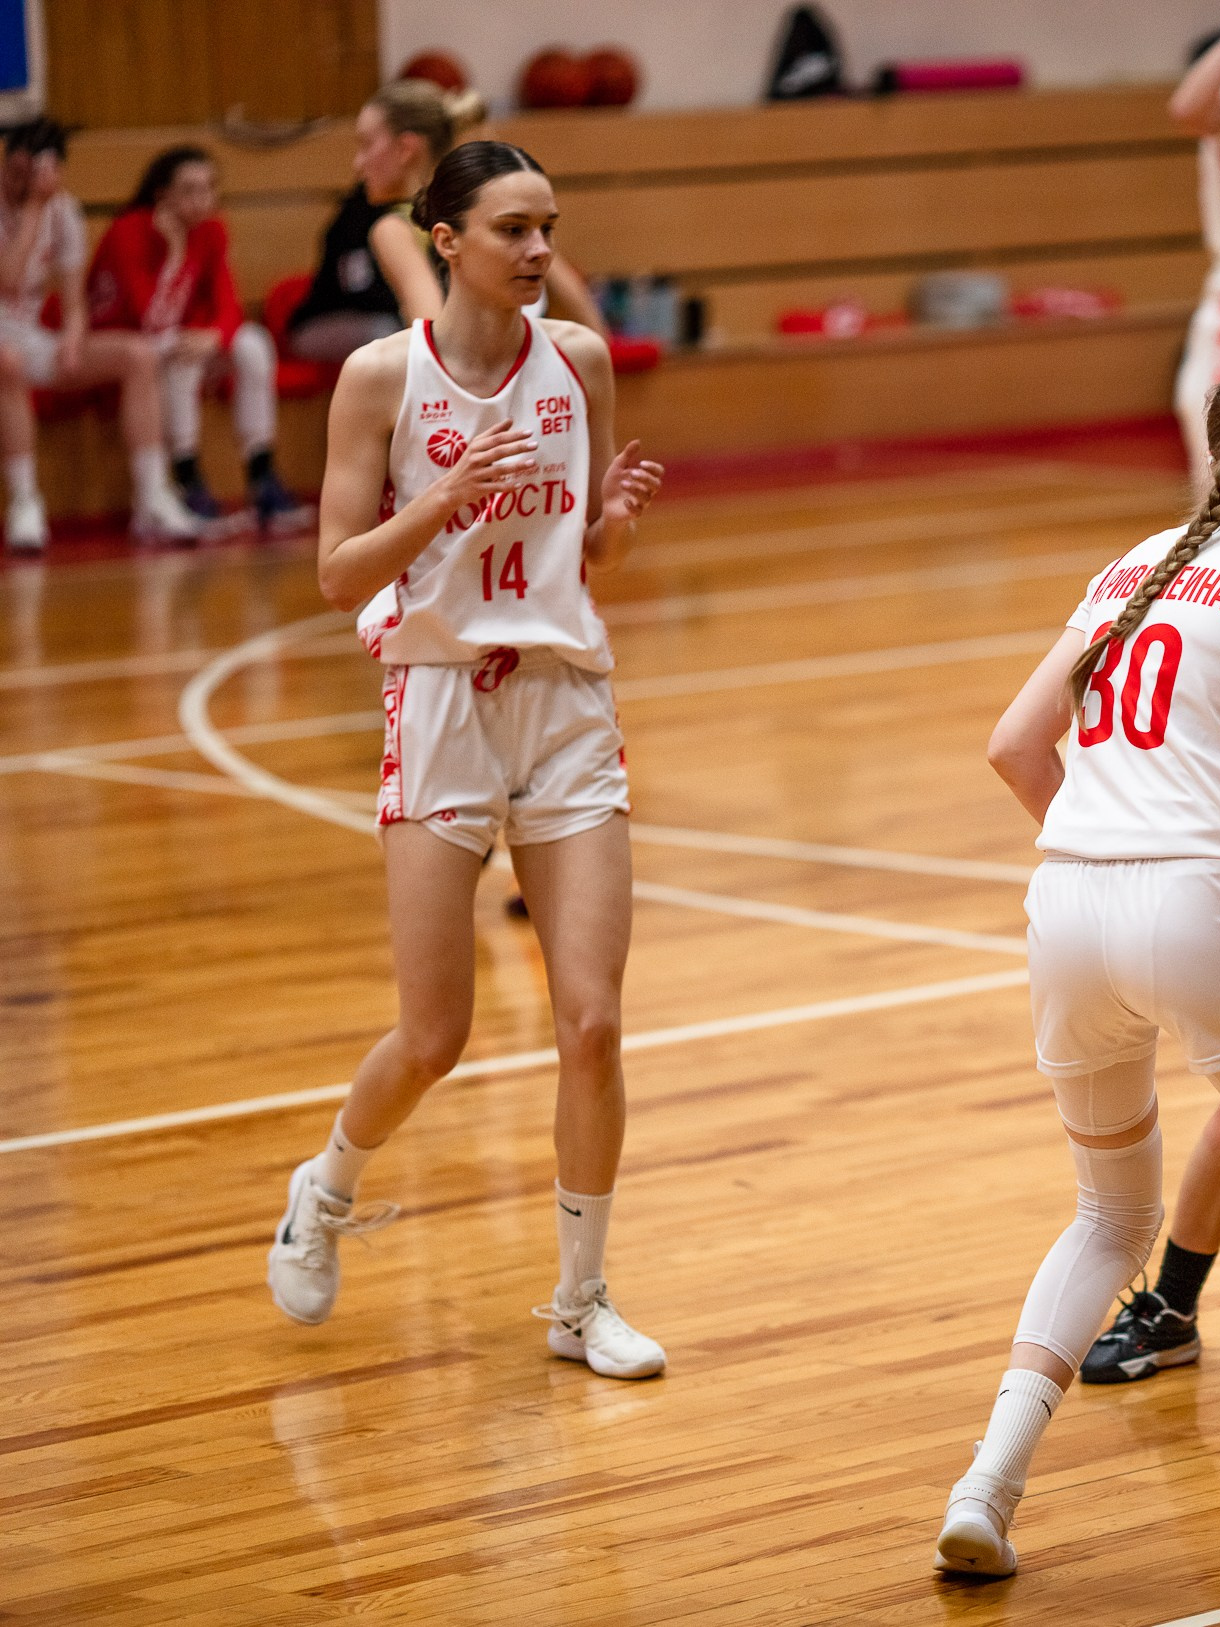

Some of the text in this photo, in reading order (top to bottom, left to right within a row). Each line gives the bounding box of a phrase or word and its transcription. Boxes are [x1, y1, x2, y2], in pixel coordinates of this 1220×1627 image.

[535, 395, 571, 416] FON
[541, 415, 573, 436] BET
[479, 540, 528, 601] 14
